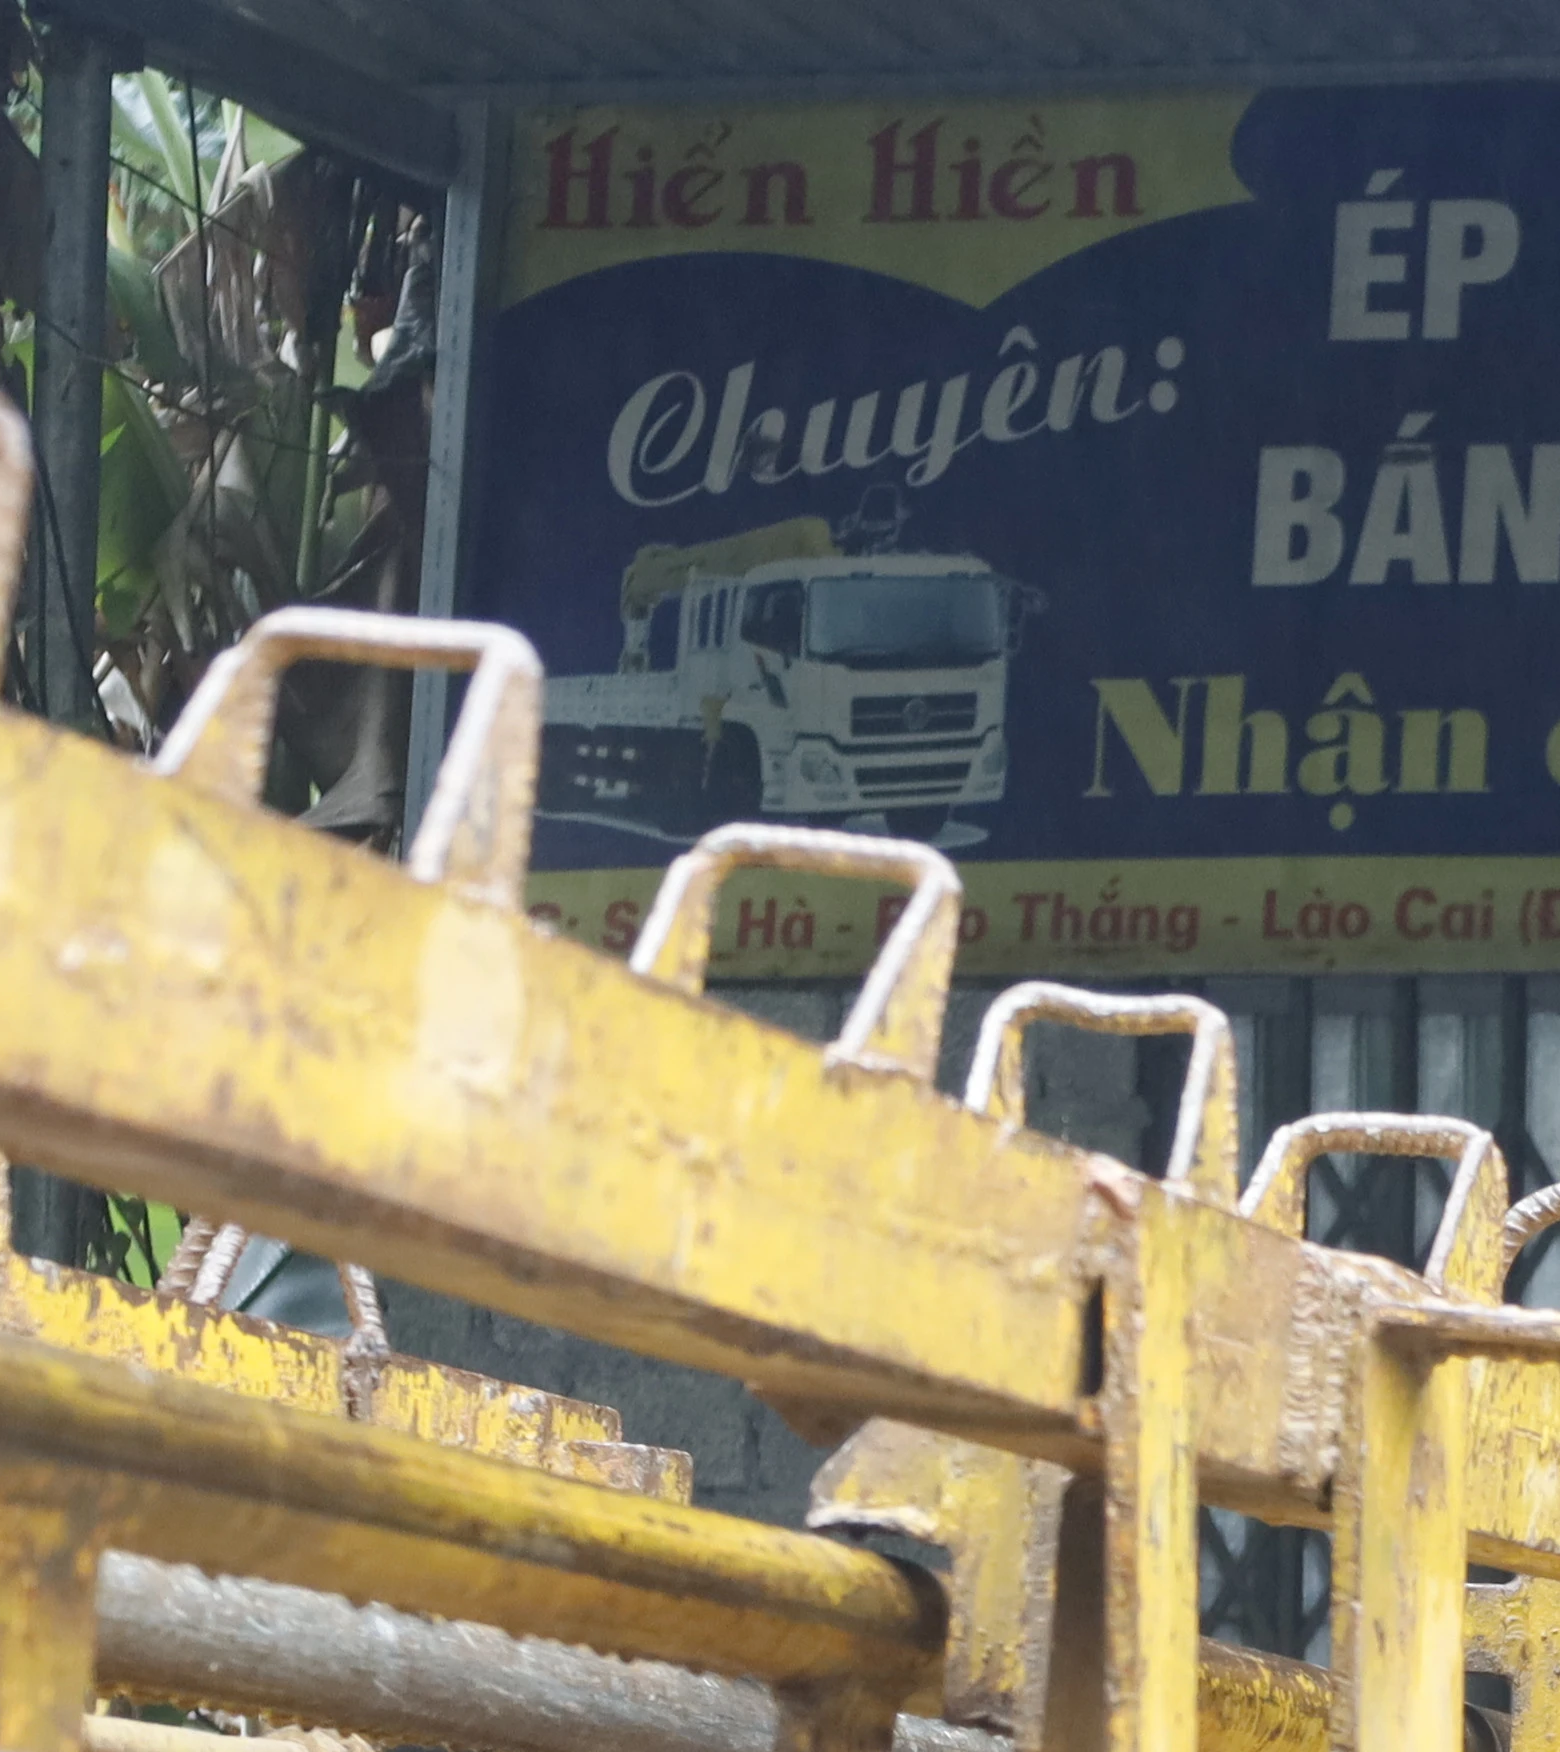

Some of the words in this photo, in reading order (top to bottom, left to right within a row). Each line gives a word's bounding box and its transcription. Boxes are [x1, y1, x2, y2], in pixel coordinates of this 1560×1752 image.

[860, 113, 1144, 223] Hiền
[1329, 169, 1519, 340] ÉP
[608, 326, 1183, 507] Chuyên:
[1084, 673, 1488, 830] Nhận
[738, 898, 816, 950] Hà
[1012, 876, 1199, 953] Thắng
[1394, 888, 1494, 942] Cai
